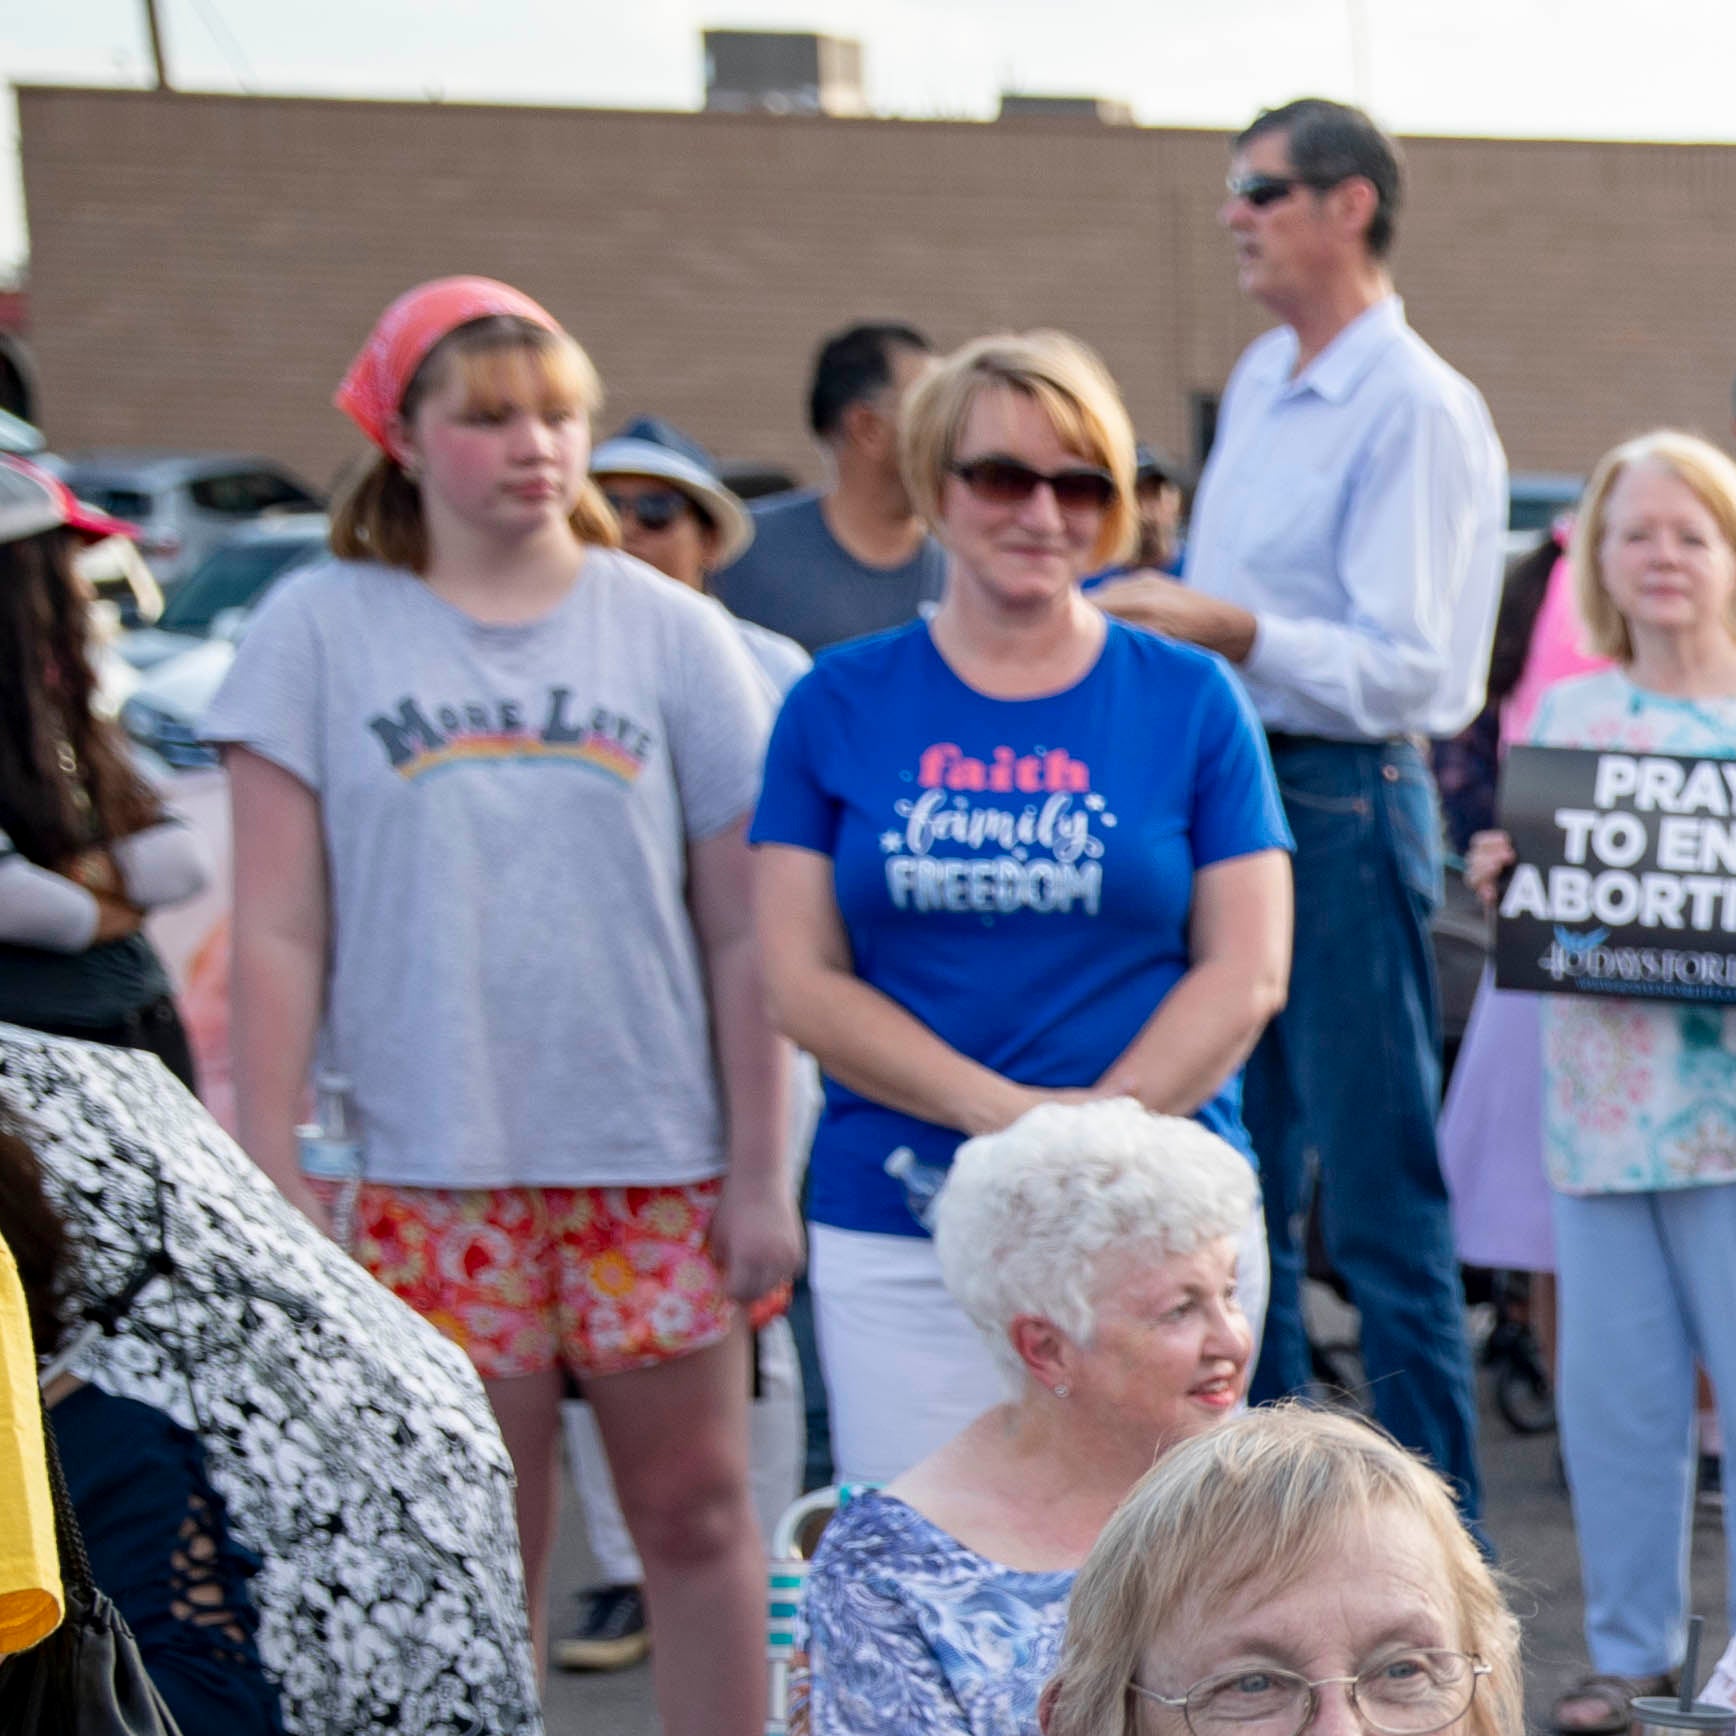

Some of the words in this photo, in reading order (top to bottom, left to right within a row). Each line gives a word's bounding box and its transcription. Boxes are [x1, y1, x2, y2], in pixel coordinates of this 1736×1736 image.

[917, 742, 1090, 793] faith
[894, 787, 1106, 863] family
[1554, 807, 1649, 868] TO
[885, 855, 1104, 918] FREEDOM
